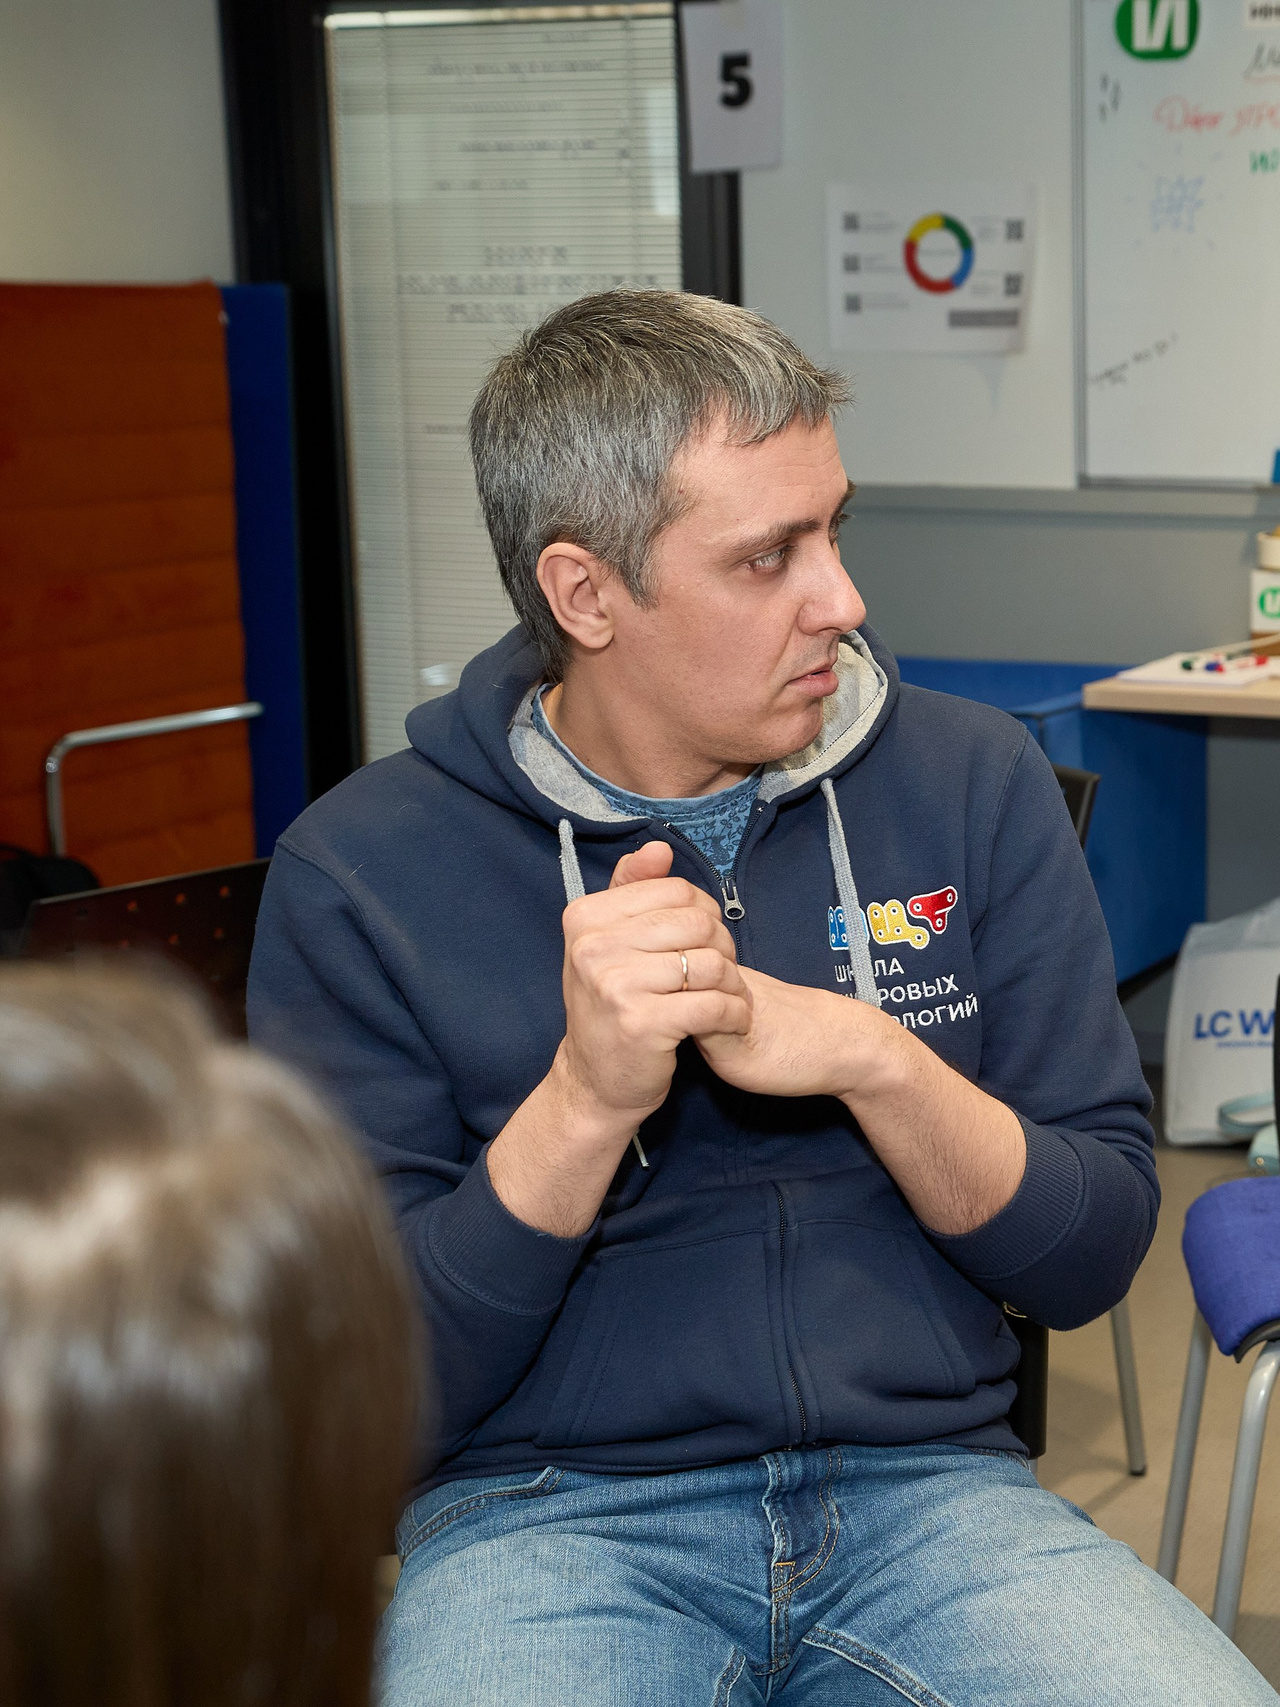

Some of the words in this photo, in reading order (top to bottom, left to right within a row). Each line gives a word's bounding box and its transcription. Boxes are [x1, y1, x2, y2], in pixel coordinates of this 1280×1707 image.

[720, 53, 754, 110] 5
[840, 973, 959, 1007] РОВЫХ
[1194, 1010, 1232, 1039] LC
